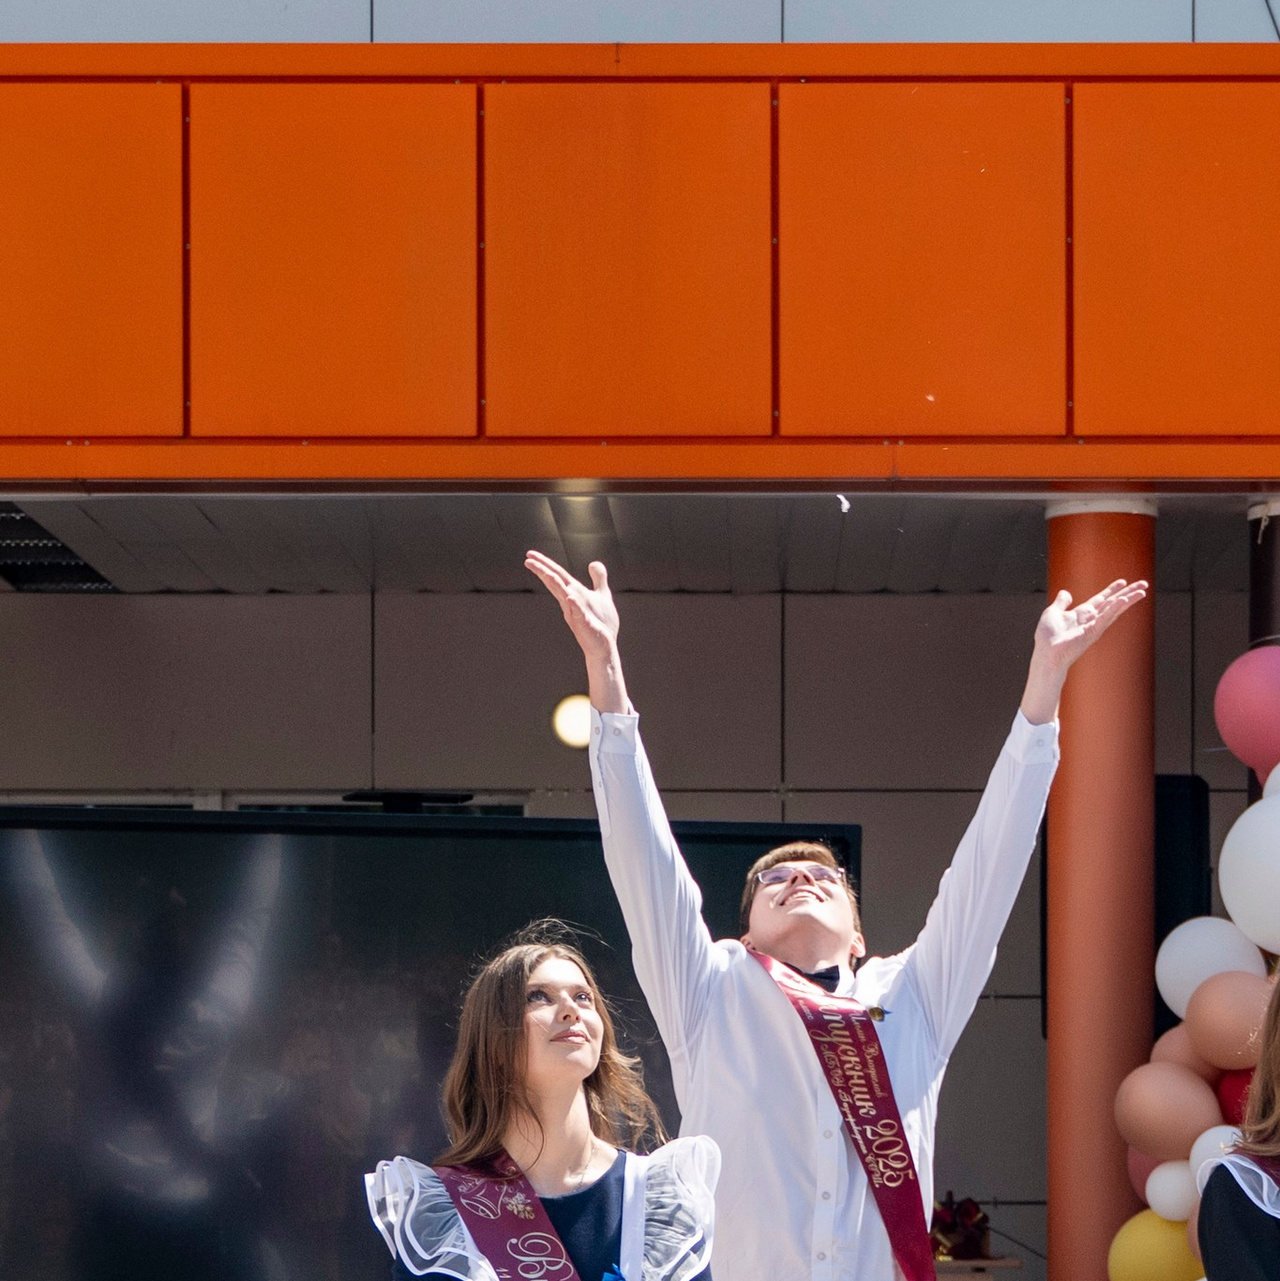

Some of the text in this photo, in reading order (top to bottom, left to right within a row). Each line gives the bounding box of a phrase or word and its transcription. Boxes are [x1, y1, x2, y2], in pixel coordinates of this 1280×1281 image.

[810, 1007, 914, 1187] пускник 2025
[496, 1267, 511, 1280] 11
